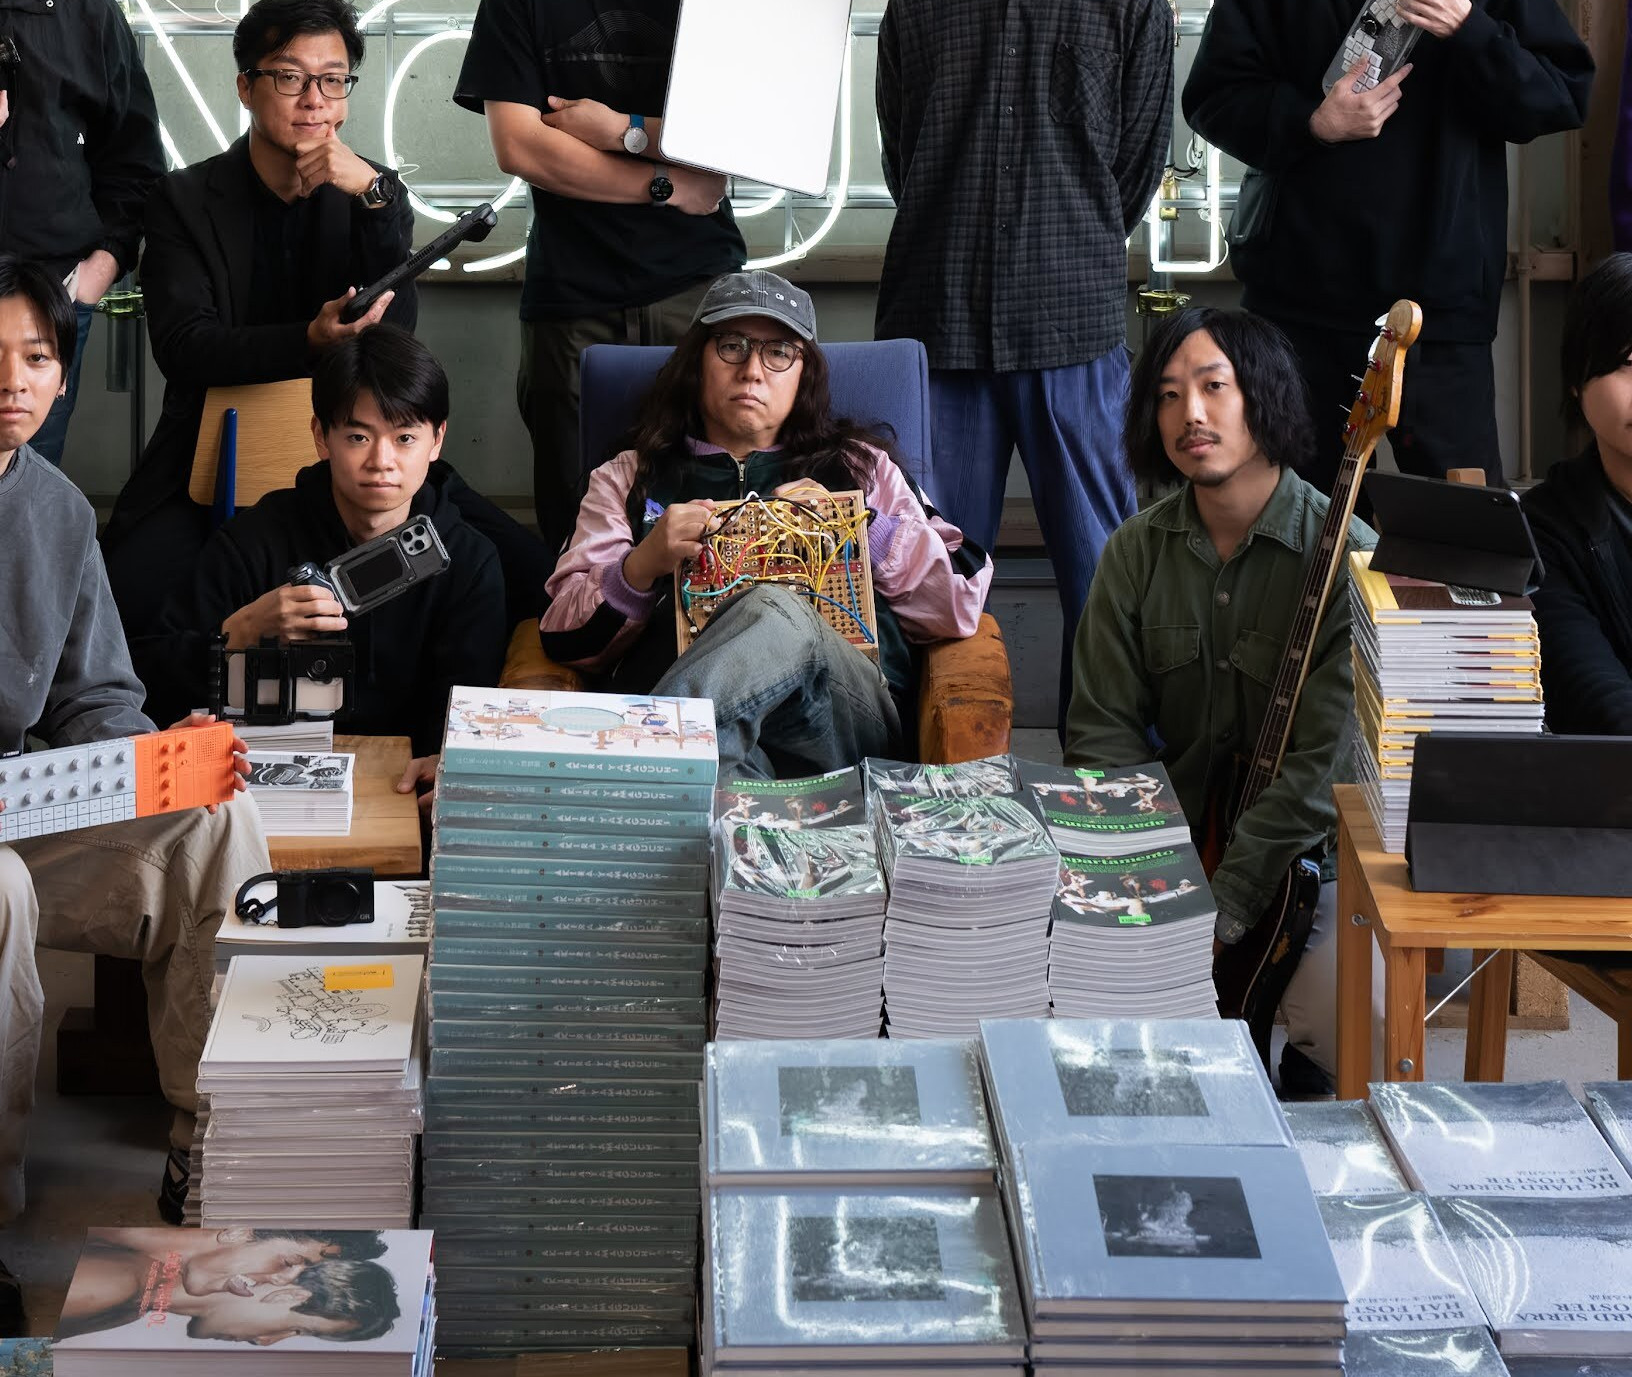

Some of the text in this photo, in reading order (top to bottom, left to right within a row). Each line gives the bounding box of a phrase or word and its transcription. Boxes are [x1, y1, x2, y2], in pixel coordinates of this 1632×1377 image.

[565, 762, 679, 773] AKIRA YAMAGUCHI
[560, 787, 674, 799] AKIRA YAMAGUCHI
[600, 816, 671, 826] YAMAGUCHI
[1052, 818, 1167, 833] apartamento
[559, 841, 672, 852] AKIRA YAMAGUCHI
[598, 871, 668, 879] YAMAGUCHI
[1484, 1174, 1615, 1184] HAL FOSTER
[1448, 1181, 1621, 1191] RICHARD SERRA
[1515, 1312, 1588, 1322] SERRA
